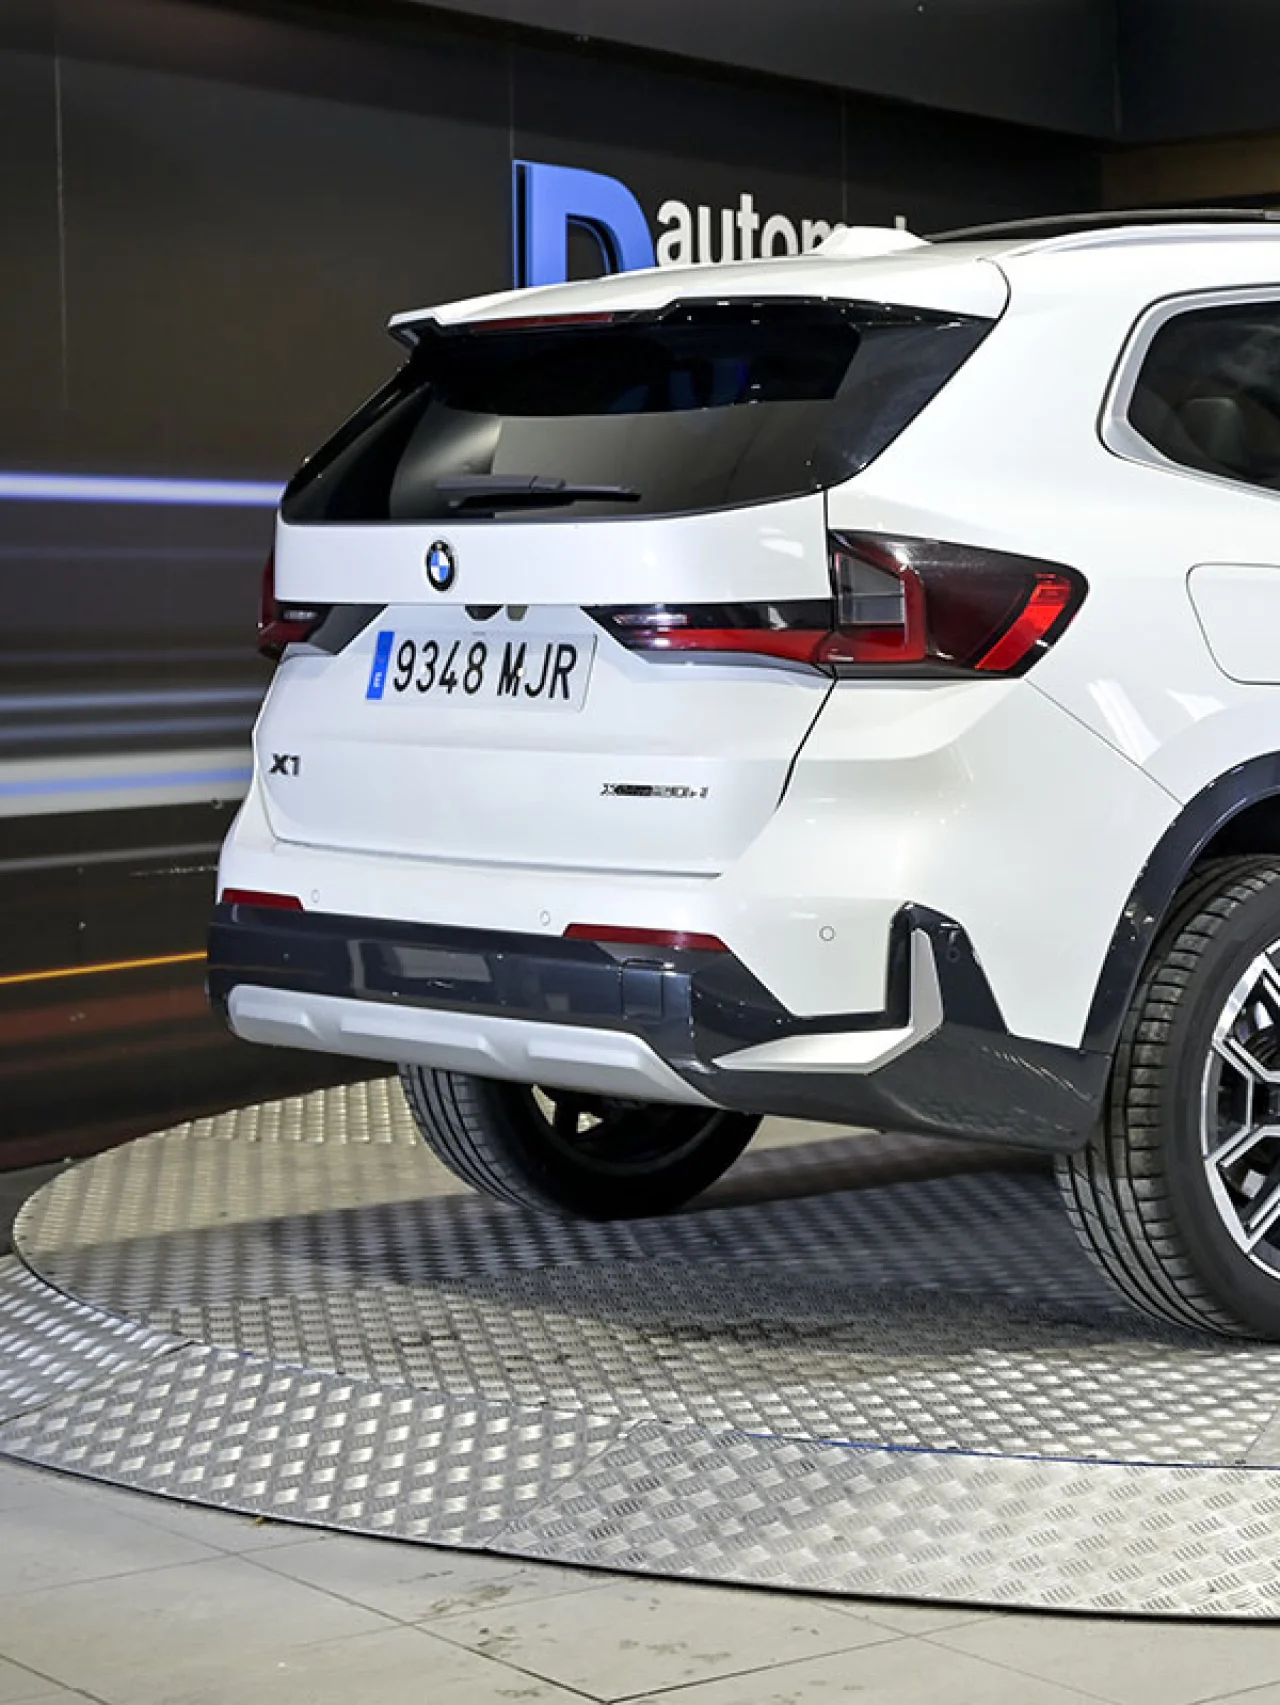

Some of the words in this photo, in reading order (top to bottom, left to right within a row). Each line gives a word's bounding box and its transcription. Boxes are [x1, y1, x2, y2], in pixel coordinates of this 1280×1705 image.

[393, 639, 487, 695] 9348
[496, 641, 577, 699] MJR
[269, 753, 300, 777] X1
